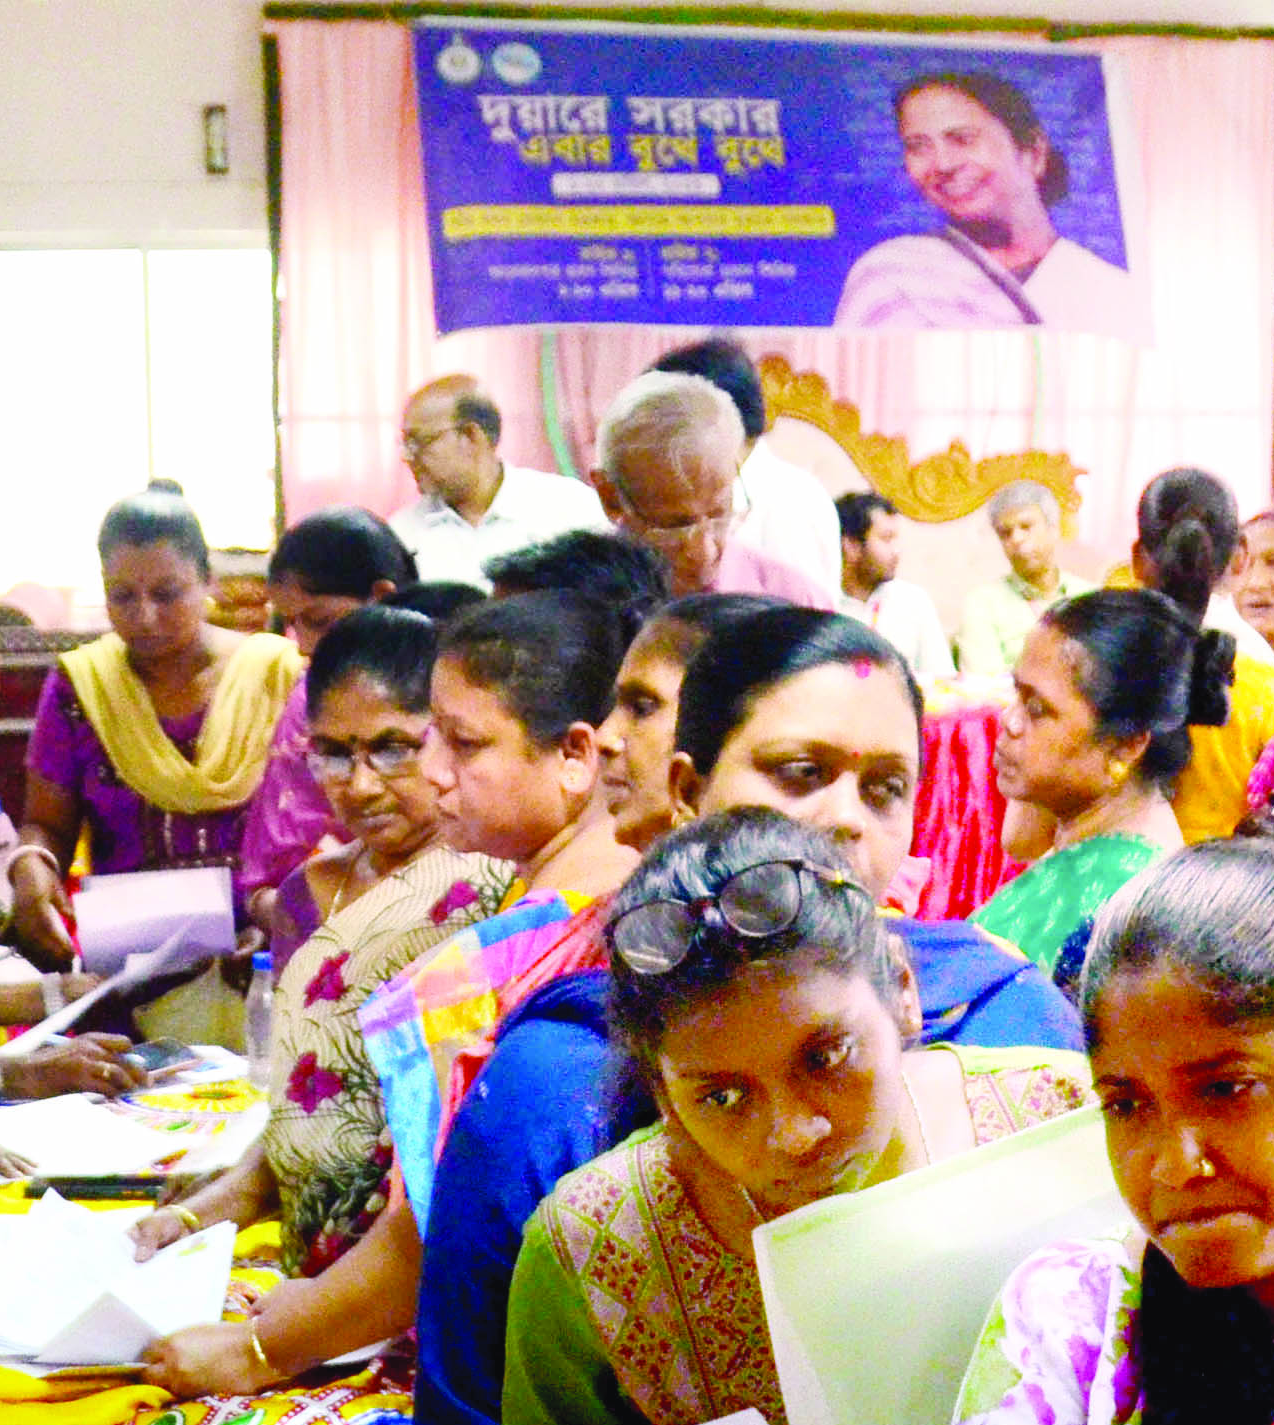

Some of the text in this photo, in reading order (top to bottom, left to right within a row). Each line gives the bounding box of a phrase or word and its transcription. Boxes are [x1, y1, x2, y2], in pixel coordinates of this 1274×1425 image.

[479, 96, 780, 141] দুয়ারে সরকার
[519, 134, 612, 165] এবার
